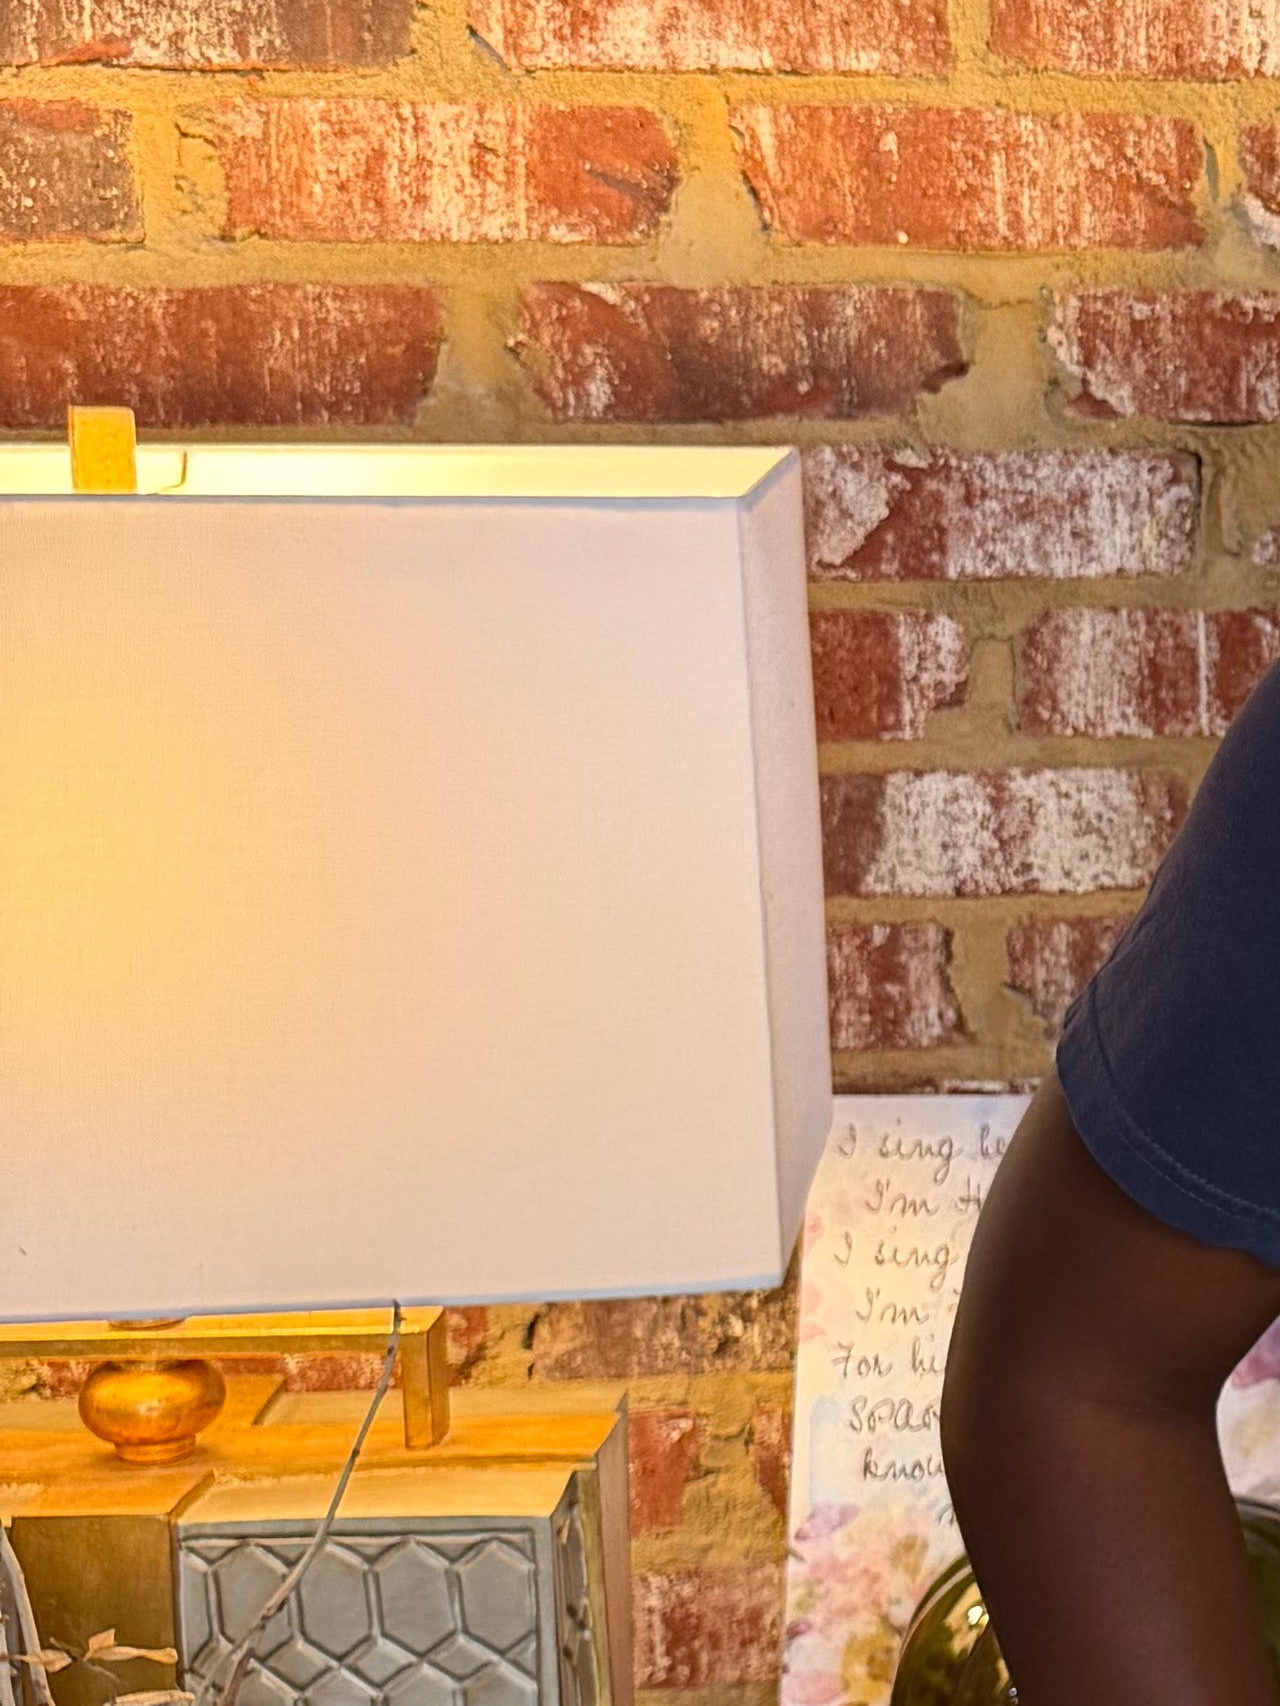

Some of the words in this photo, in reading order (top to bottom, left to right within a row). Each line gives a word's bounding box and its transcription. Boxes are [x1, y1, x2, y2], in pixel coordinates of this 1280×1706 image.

[877, 1118, 961, 1186] sing
[978, 1122, 1007, 1161] be
[865, 1177, 939, 1219] I'm
[874, 1225, 958, 1292] sing
[856, 1286, 930, 1325] I'm
[831, 1340, 893, 1379] For
[911, 1333, 945, 1374] hi
